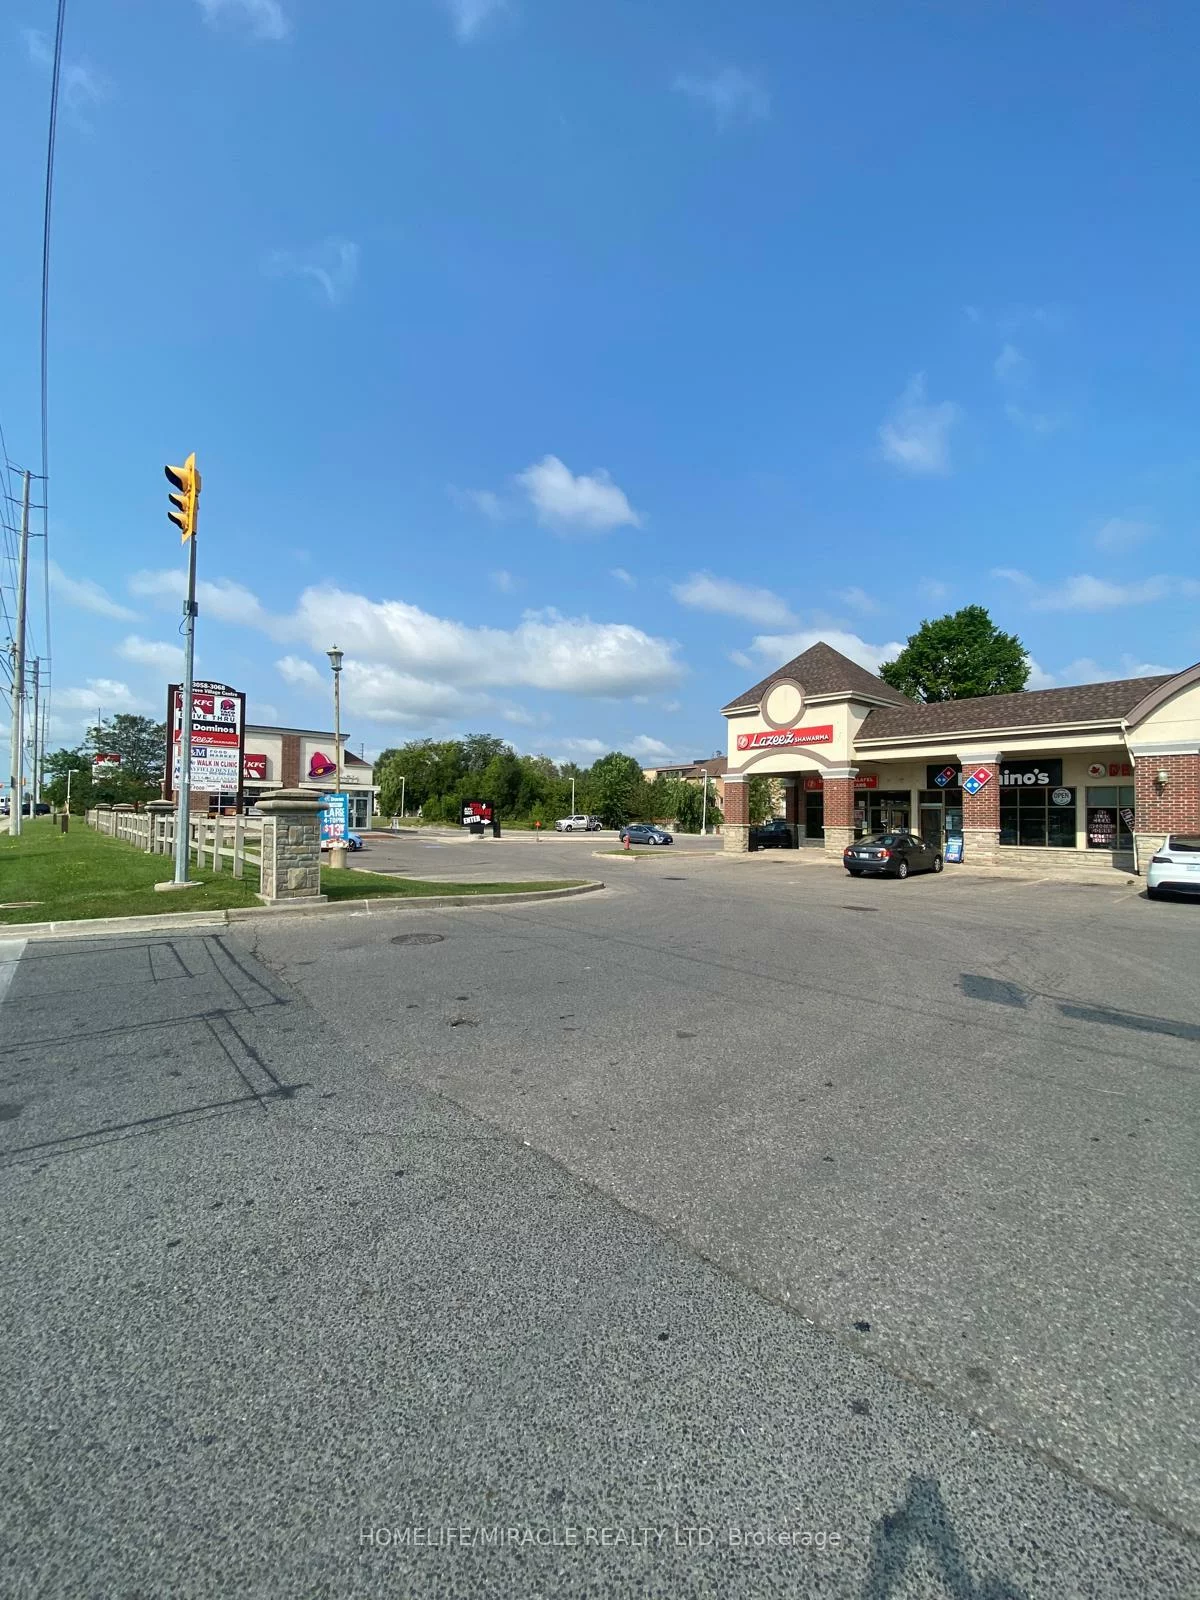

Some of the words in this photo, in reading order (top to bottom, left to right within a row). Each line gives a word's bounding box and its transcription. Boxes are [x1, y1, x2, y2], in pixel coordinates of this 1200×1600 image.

[193, 699, 214, 707] KFC
[794, 734, 829, 743] SHAWARMA
[220, 760, 238, 768] CLINIC
[1053, 791, 1070, 799] OPEN
